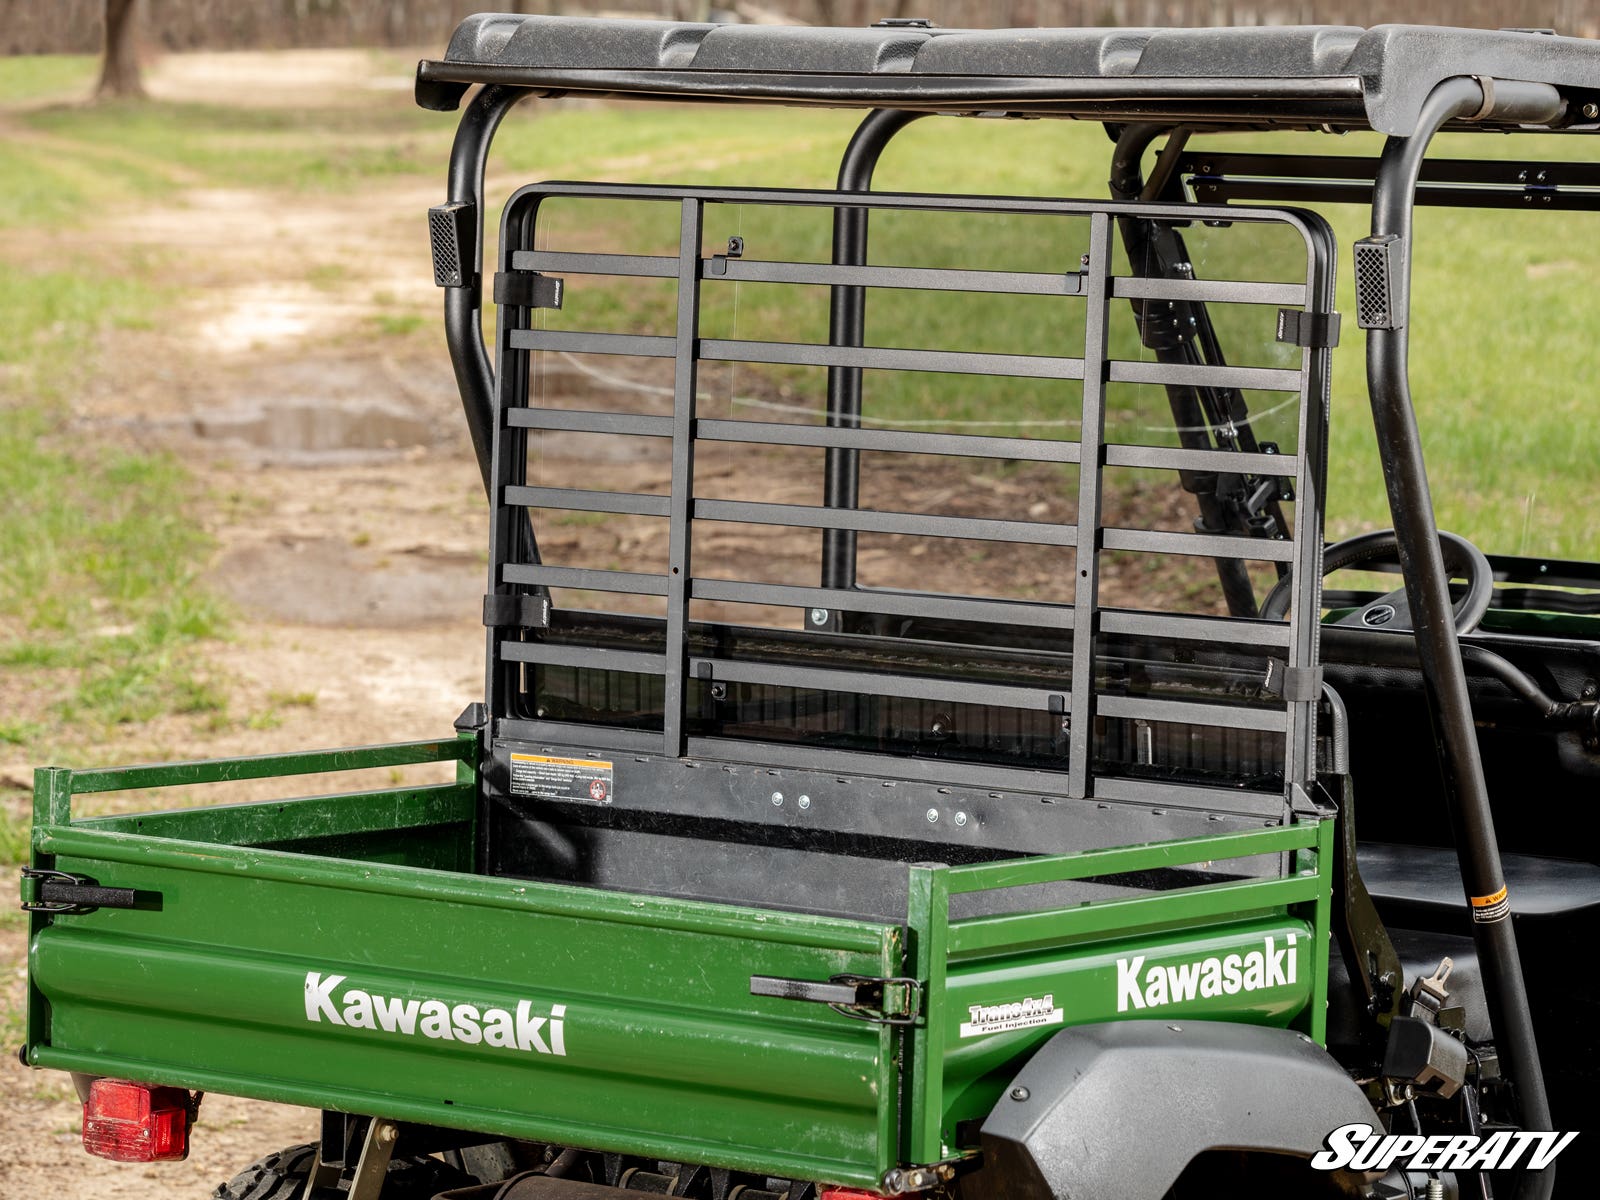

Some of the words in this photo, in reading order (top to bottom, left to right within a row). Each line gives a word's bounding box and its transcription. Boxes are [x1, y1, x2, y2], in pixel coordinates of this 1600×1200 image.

[1116, 933, 1297, 1012] Kawasaki
[304, 971, 567, 1056] Kawasaki
[969, 994, 1053, 1027] Trans4x4
[982, 1024, 1003, 1032] Fuel
[1005, 1018, 1047, 1029] Injection
